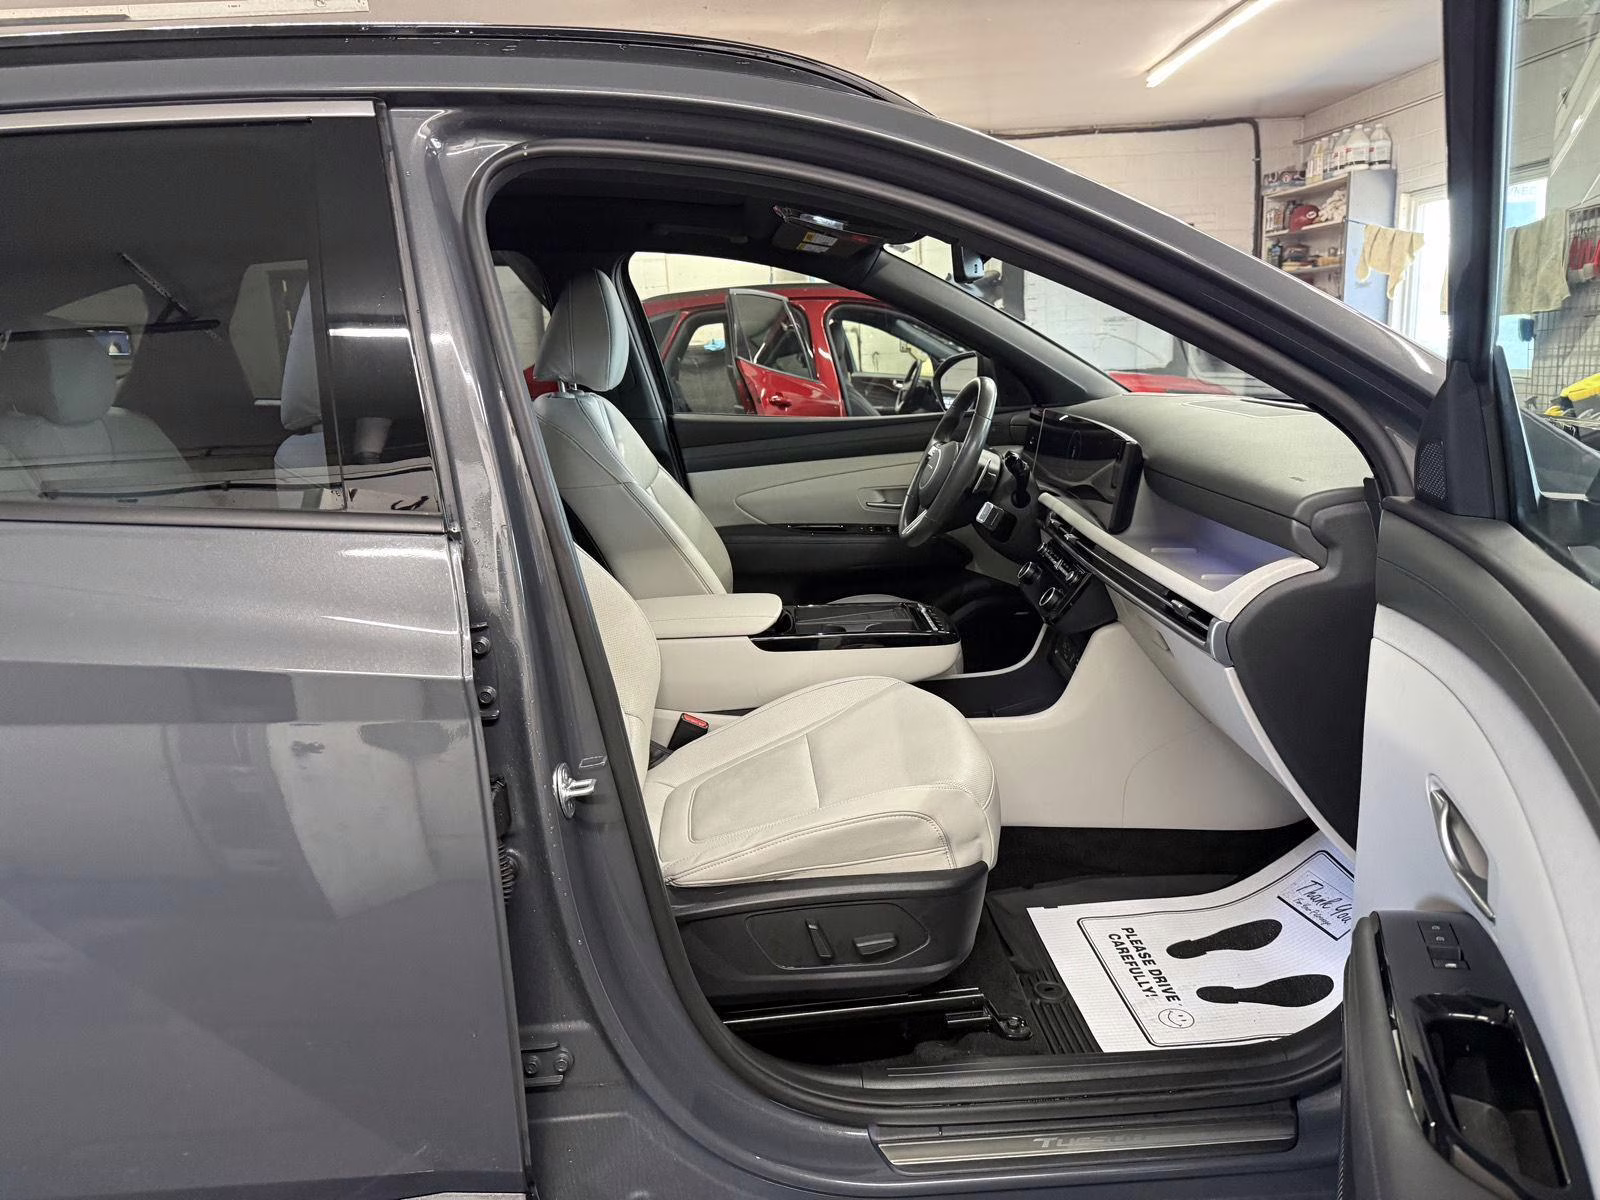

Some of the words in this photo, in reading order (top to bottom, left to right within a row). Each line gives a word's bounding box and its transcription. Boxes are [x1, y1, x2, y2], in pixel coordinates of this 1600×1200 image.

[1296, 880, 1342, 909] Thank
[1330, 904, 1353, 923] You
[1108, 933, 1159, 998] CAREFULLY!
[1121, 927, 1157, 966] PLEASE
[1148, 969, 1182, 1002] DRIVE
